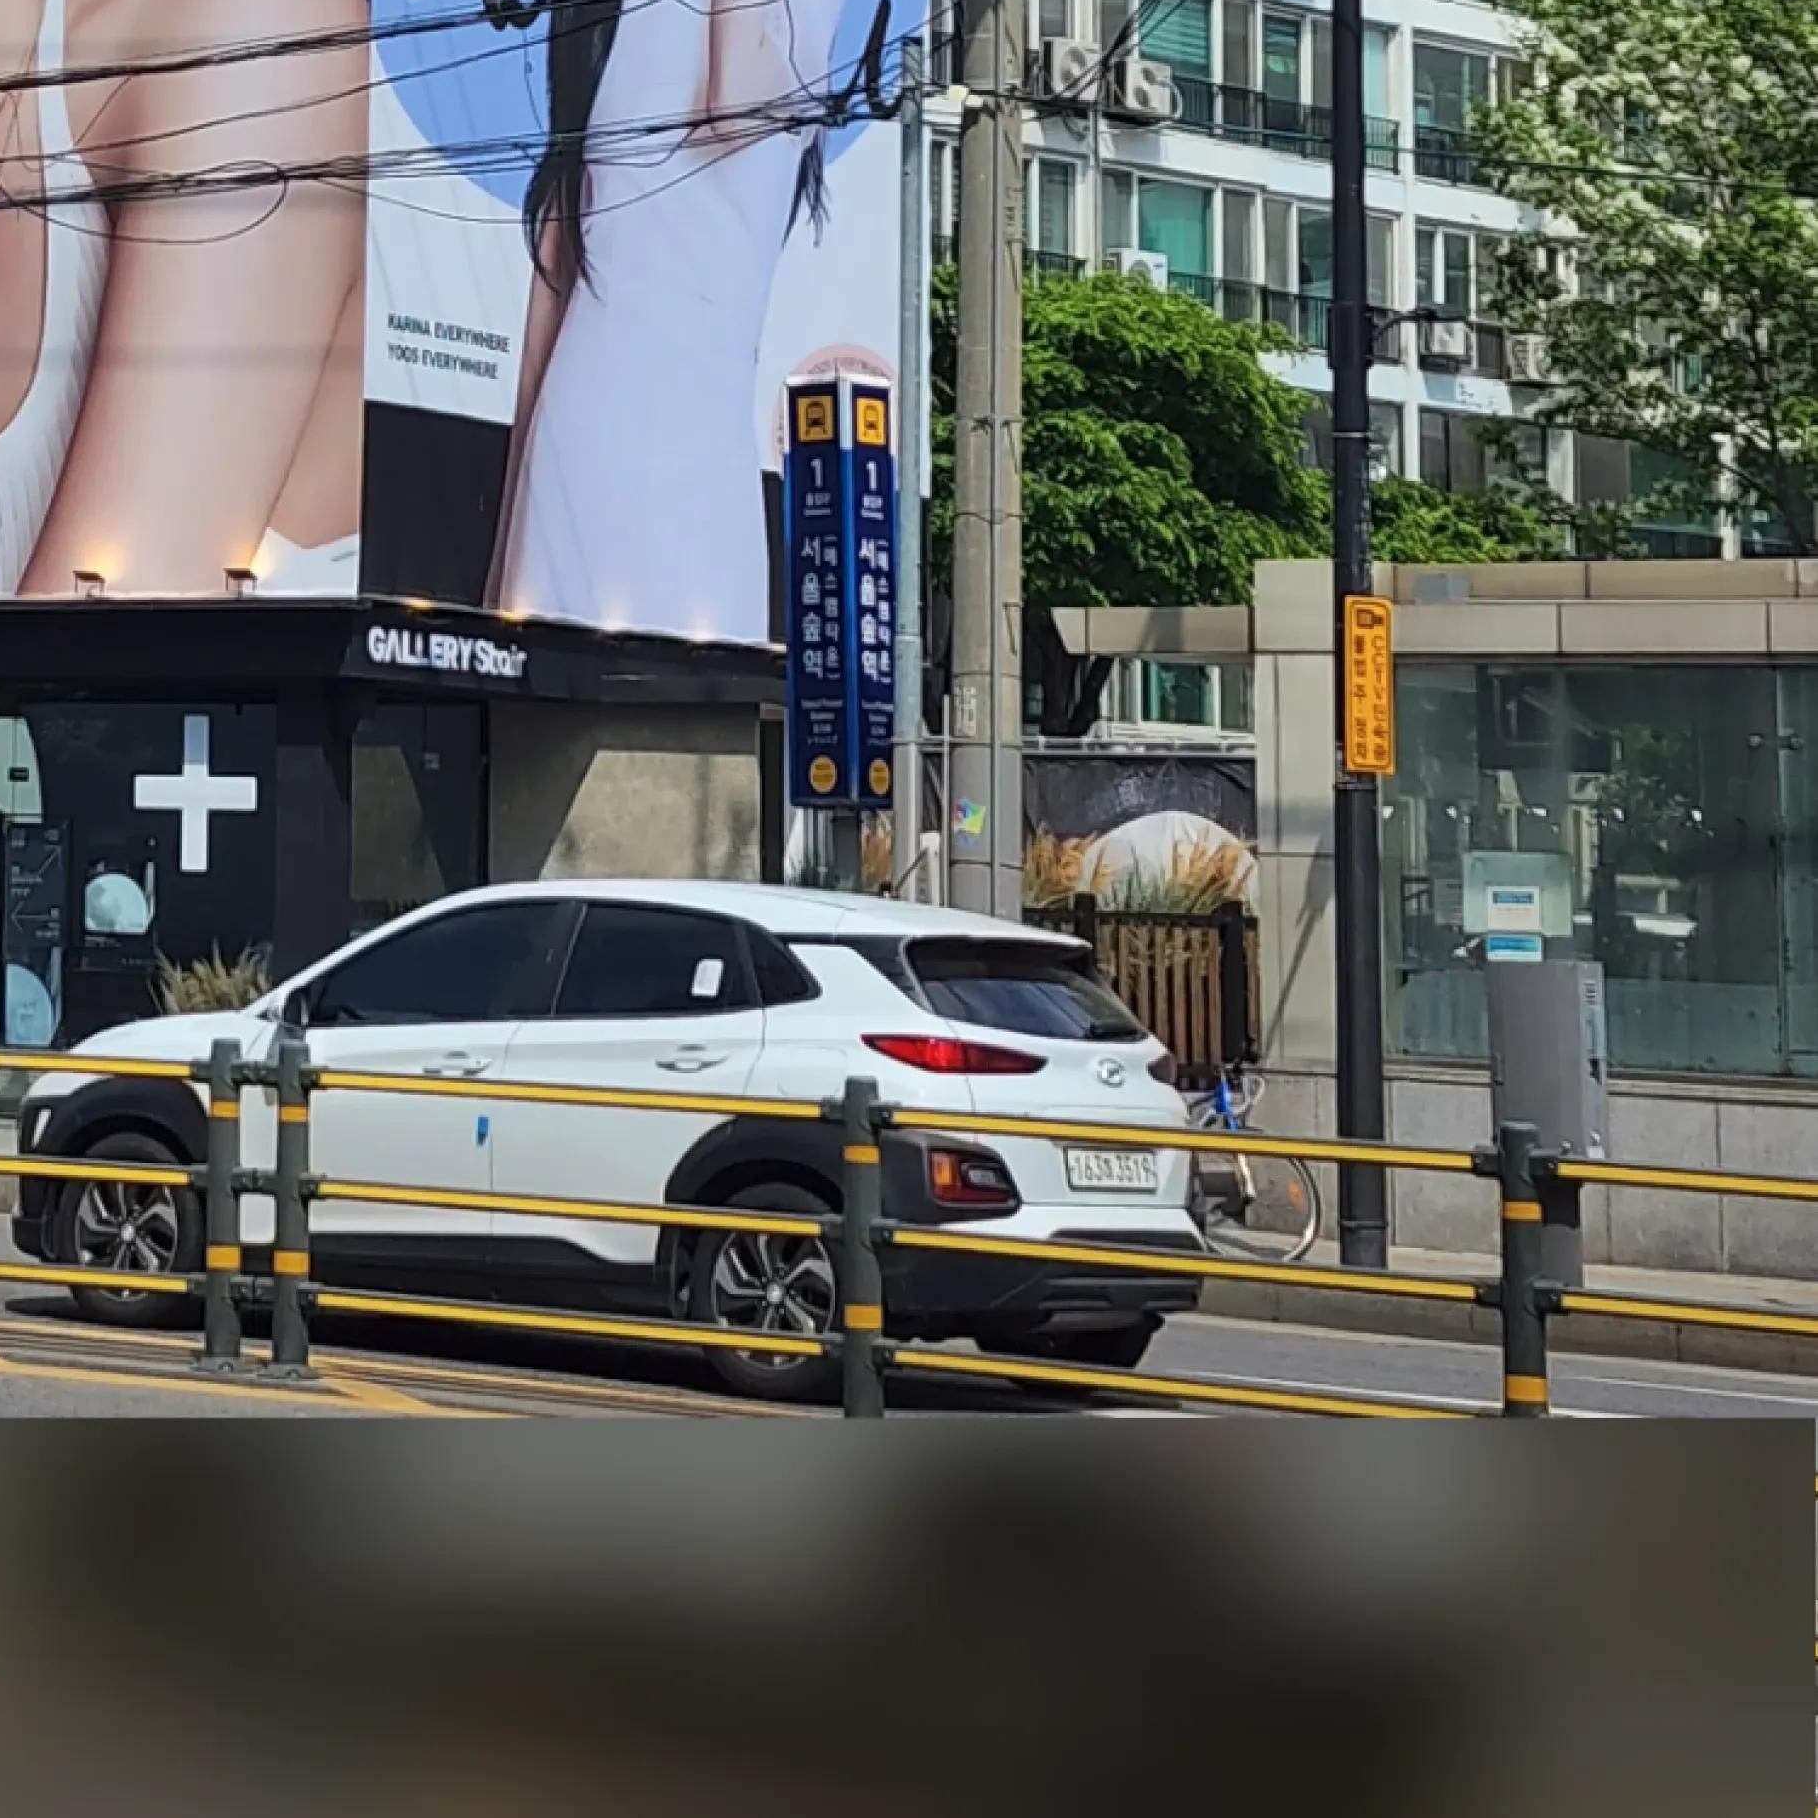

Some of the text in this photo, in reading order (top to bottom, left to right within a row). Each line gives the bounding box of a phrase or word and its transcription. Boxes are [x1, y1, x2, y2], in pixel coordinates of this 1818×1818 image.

[388, 312, 510, 353] KARINA EVERYWHERE
[388, 344, 498, 380] YOOS EVERYWHERE
[810, 458, 822, 487] 1
[865, 461, 877, 491] 1
